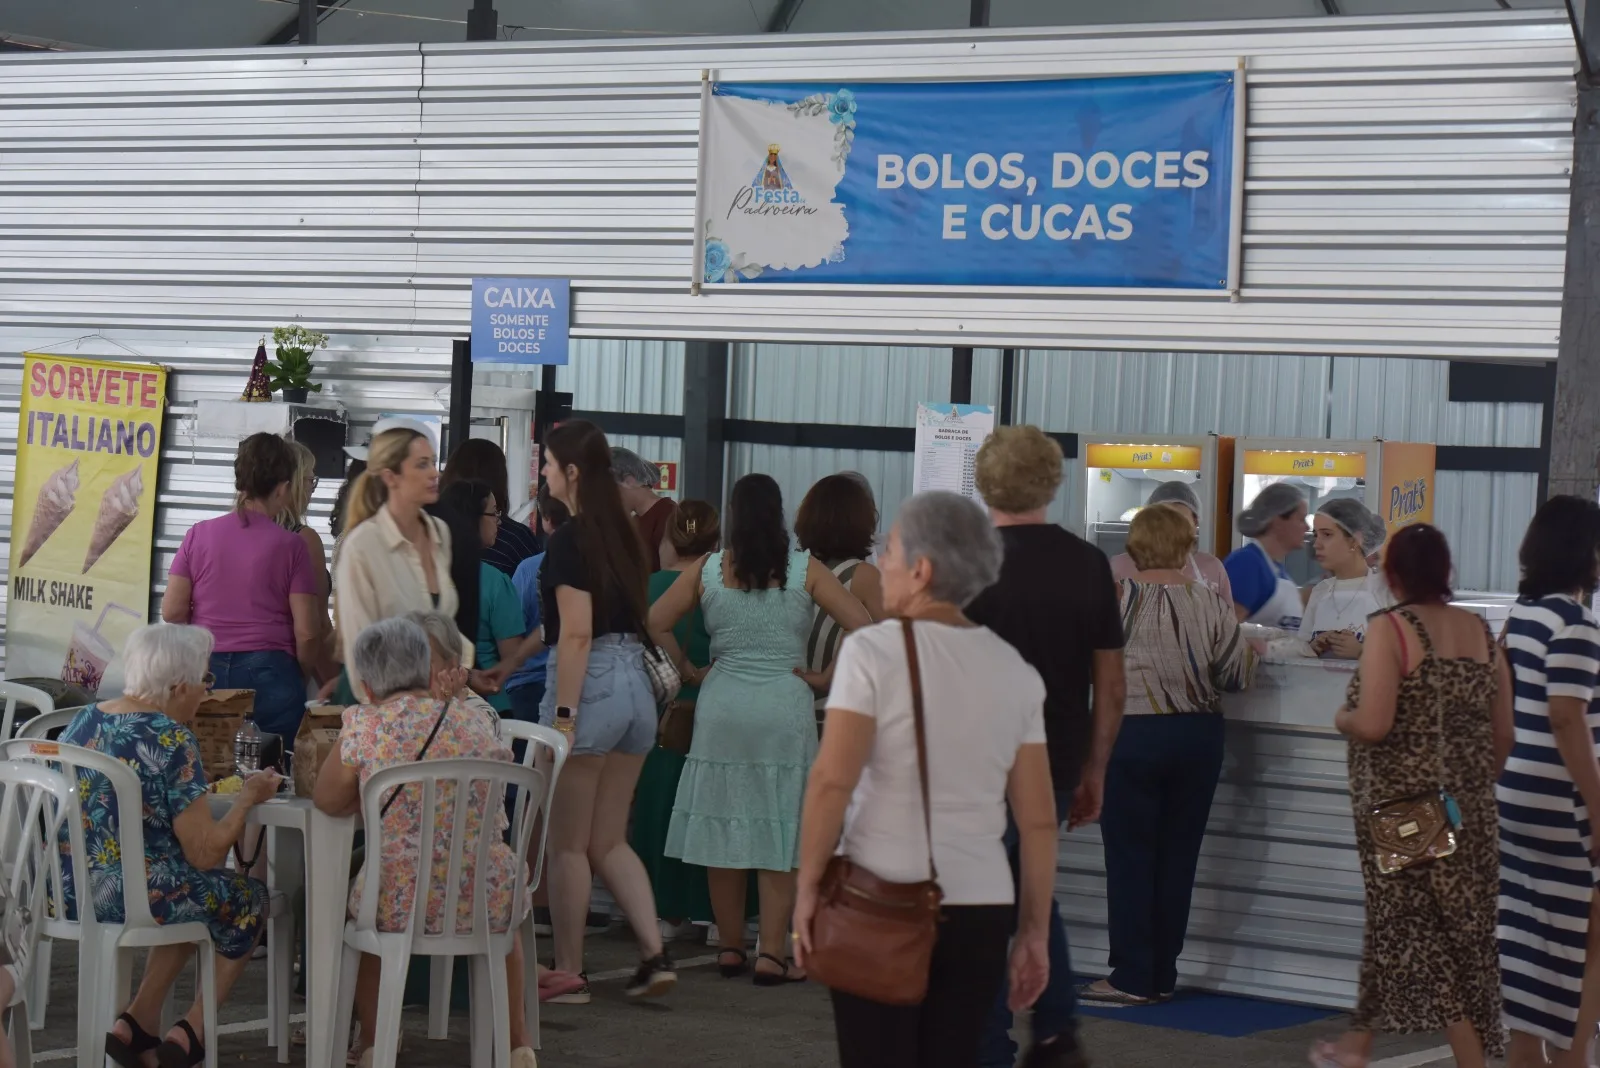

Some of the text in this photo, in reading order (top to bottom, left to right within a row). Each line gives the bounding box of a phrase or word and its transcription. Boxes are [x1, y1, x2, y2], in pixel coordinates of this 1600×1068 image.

[876, 151, 1210, 196] BOLOS, DOCES
[726, 185, 818, 220] Padroeira
[754, 187, 799, 204] Festa
[942, 203, 1133, 240] E CUCAS
[483, 286, 556, 309] CAIXA
[490, 313, 549, 326] SOMENTE
[493, 327, 546, 340] BOLOS E
[498, 341, 541, 354] DOCES
[30, 362, 158, 409] SORVETE
[26, 411, 156, 458] ITALIANO
[14, 576, 94, 611] MILK SHAKE
